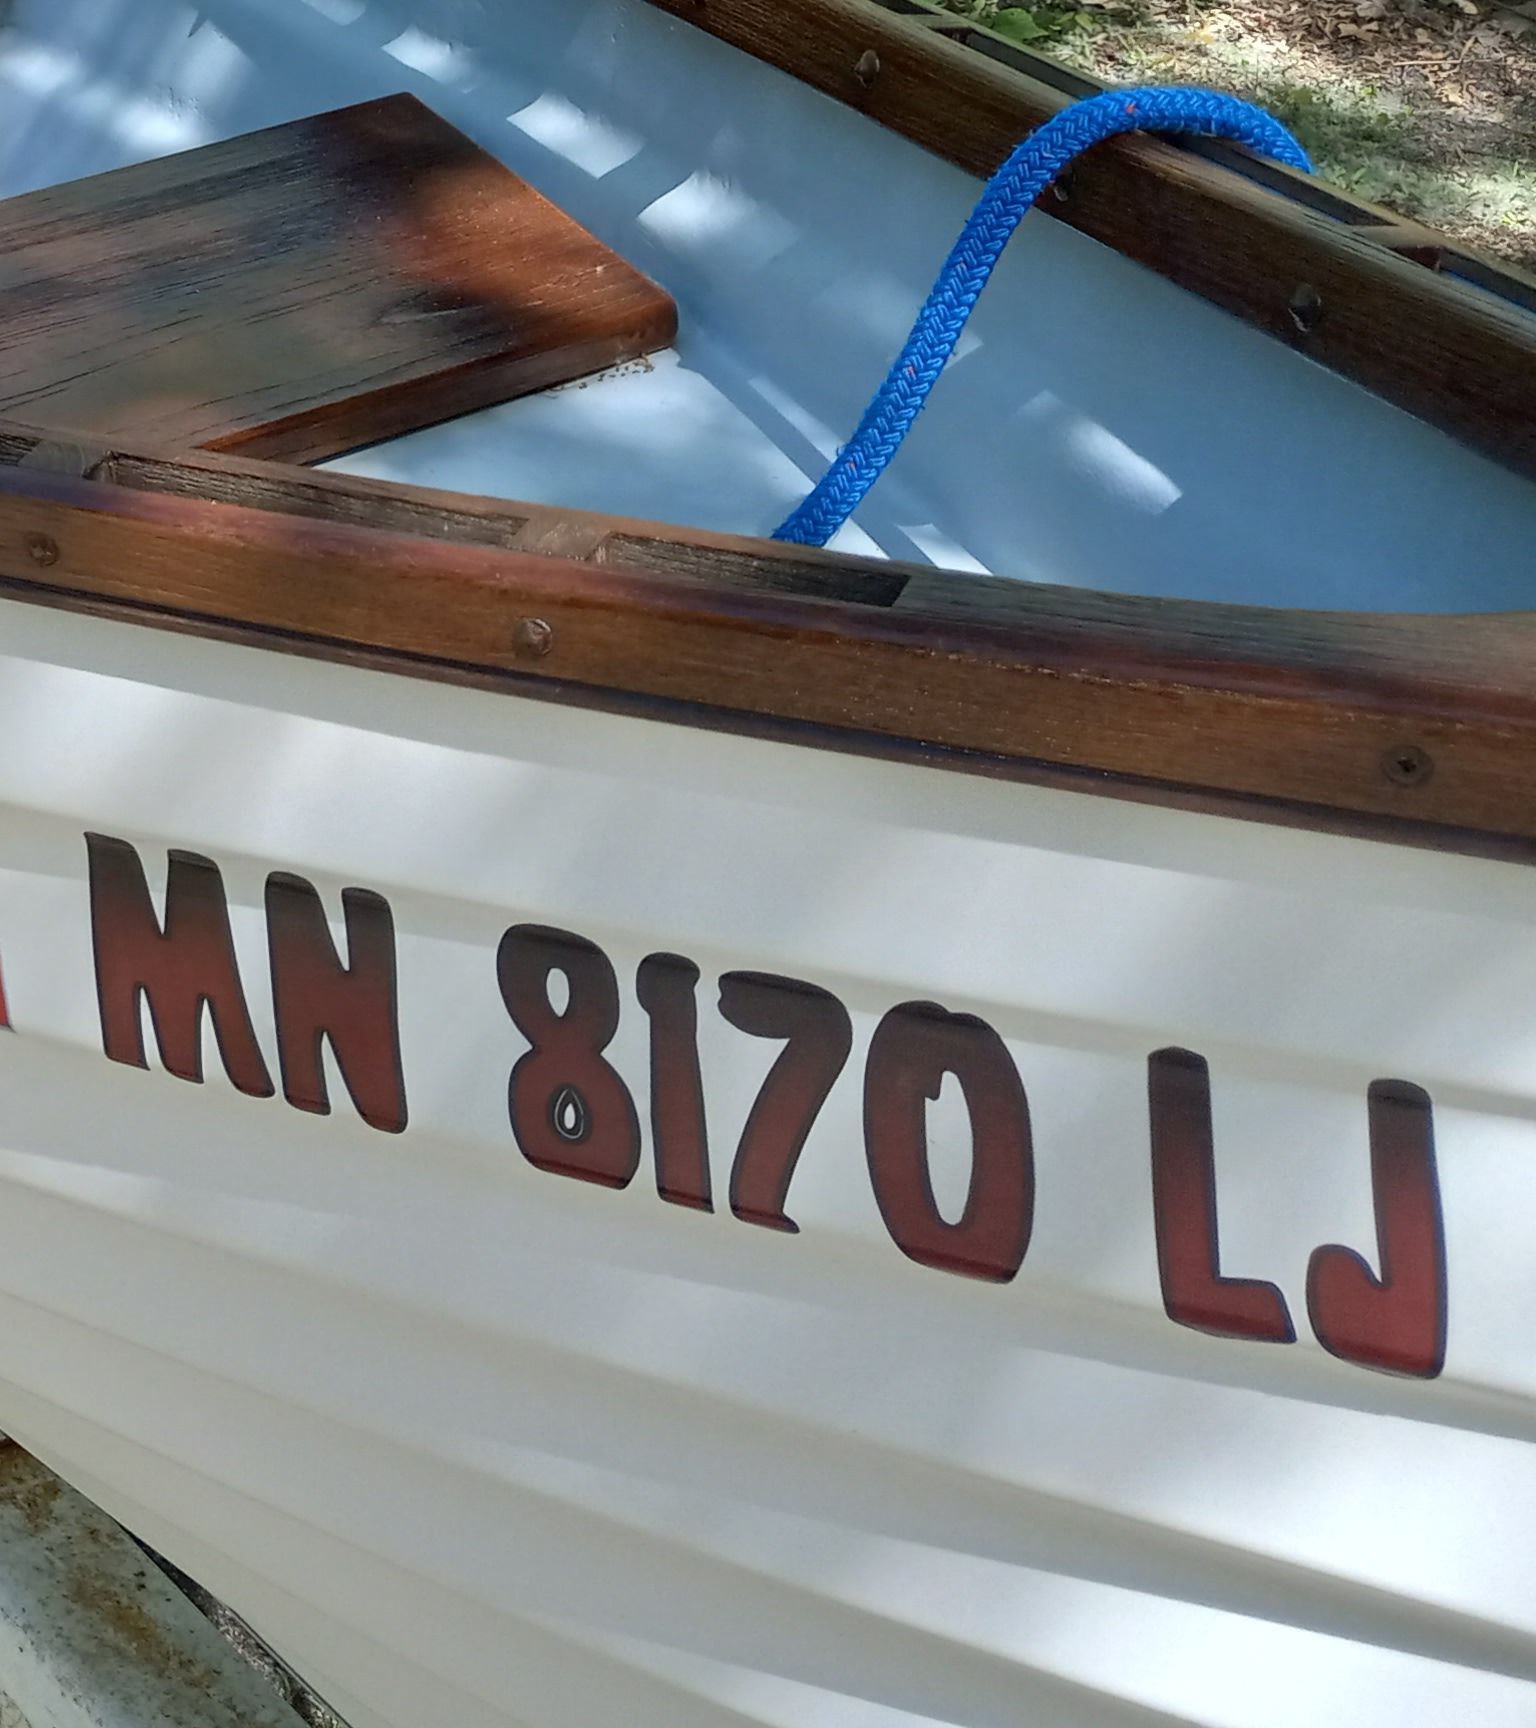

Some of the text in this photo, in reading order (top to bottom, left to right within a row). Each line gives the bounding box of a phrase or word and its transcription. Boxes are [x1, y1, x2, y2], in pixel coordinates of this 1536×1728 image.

[84, 831, 1448, 1380] MN 8170 LJ
